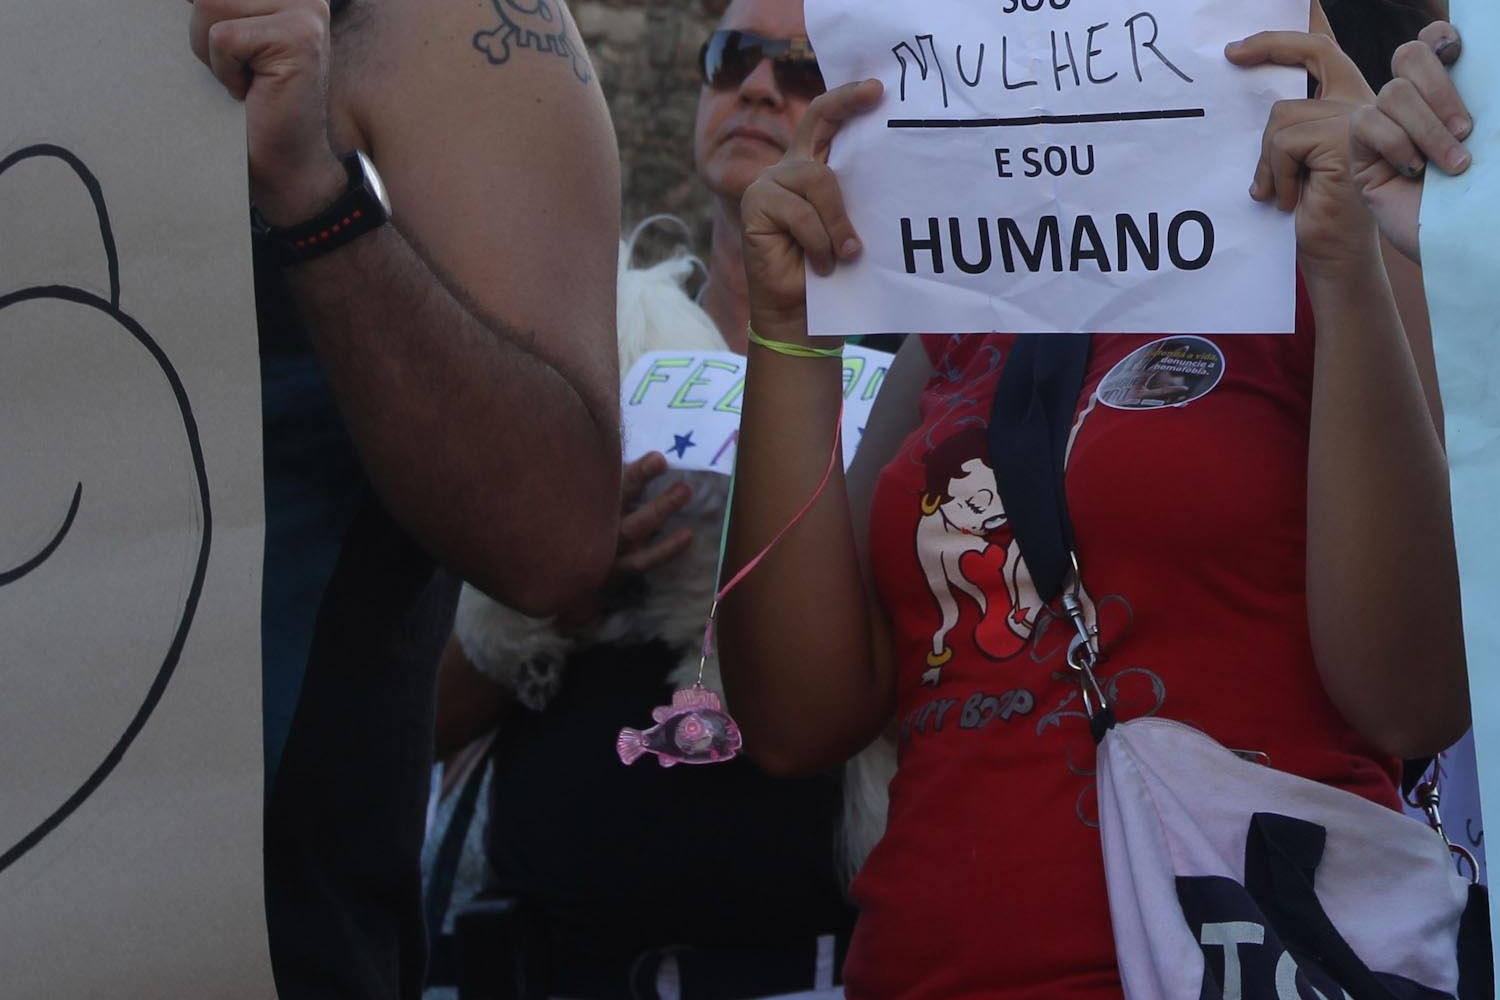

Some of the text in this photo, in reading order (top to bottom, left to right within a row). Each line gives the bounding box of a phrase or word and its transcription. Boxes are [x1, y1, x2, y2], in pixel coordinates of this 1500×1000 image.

[892, 11, 1194, 108] MULHER
[995, 144, 1095, 178] E SOU
[900, 210, 1215, 275] HUMANO
